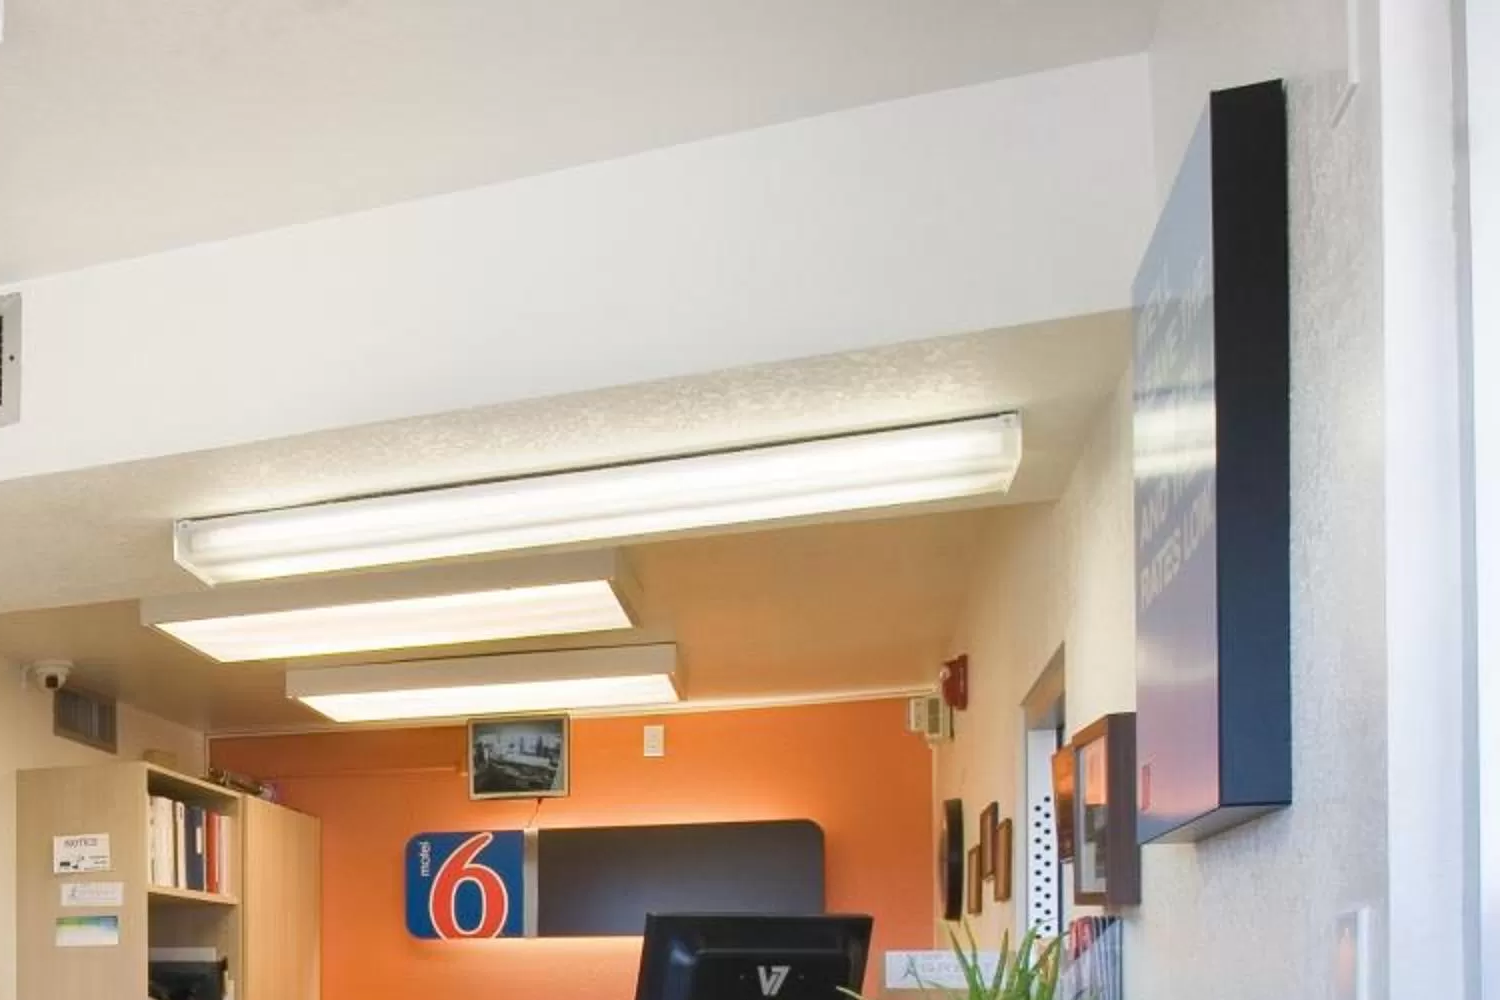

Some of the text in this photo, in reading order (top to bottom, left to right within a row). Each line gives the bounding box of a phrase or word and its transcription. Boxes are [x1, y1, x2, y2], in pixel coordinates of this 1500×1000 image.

[1140, 527, 1182, 612] RATES
[64, 838, 97, 848] NOTICE
[419, 841, 431, 877] motel
[429, 832, 509, 940] 6
[756, 965, 792, 996] V7
